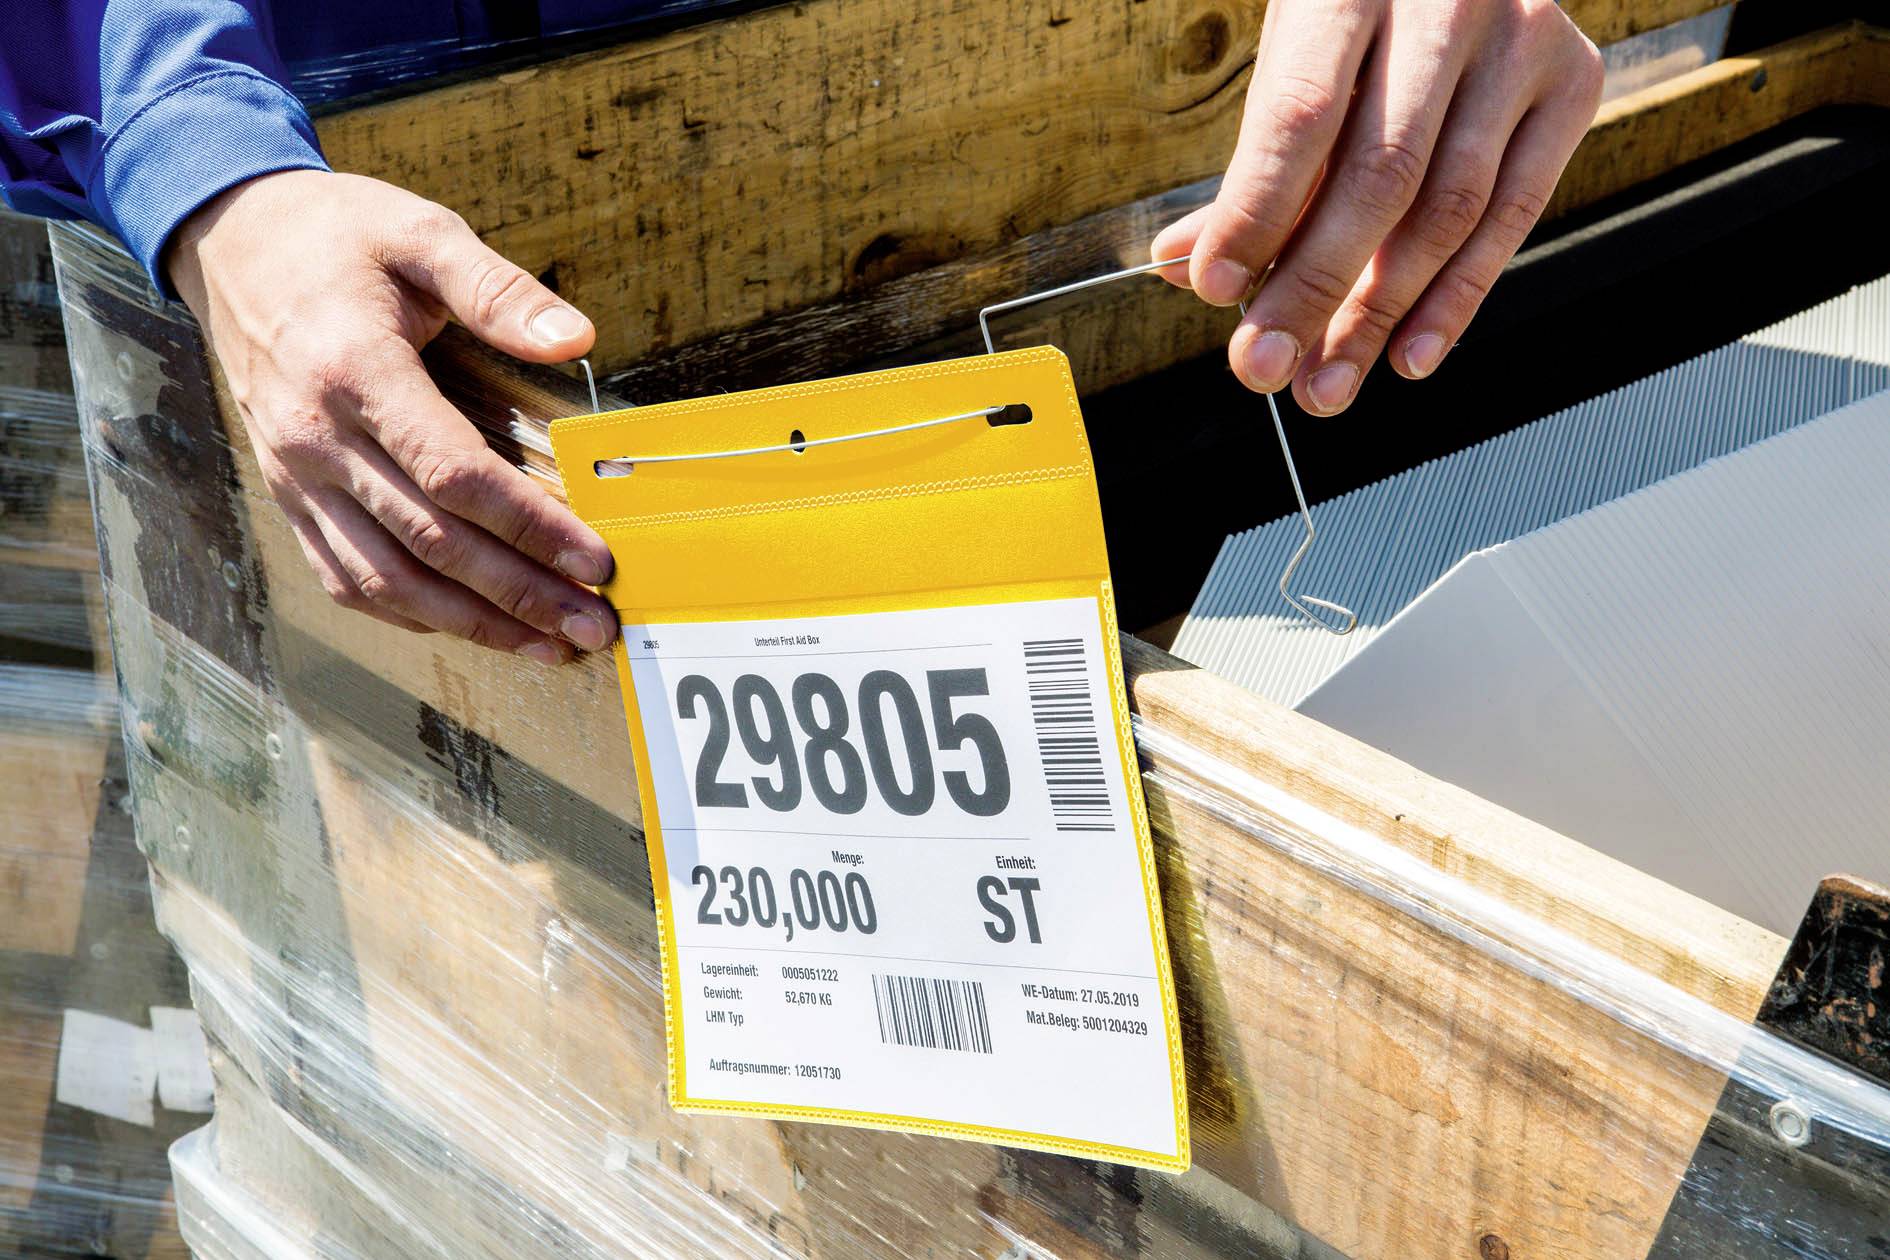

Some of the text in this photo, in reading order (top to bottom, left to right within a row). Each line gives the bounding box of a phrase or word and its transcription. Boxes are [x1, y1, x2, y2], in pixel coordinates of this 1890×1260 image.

[754, 634, 820, 647] Unterteil First Aid Box
[676, 667, 1011, 817] 29805
[832, 850, 865, 867] Menge:
[995, 855, 1036, 870] Einheit:
[692, 865, 878, 943] 230,000
[976, 875, 1042, 945] ST
[701, 962, 839, 982] Lagereinheit: 0005051222
[703, 986, 832, 1006] Gewicht: 52,670 KG
[1021, 983, 1140, 1008] WE-Datum: 27.05.2019
[706, 1010, 744, 1027] LHM Typ
[1026, 1010, 1148, 1036] Mat.Beleg: 5001204329
[709, 1058, 841, 1081] Auftragsnummer: 12051730
